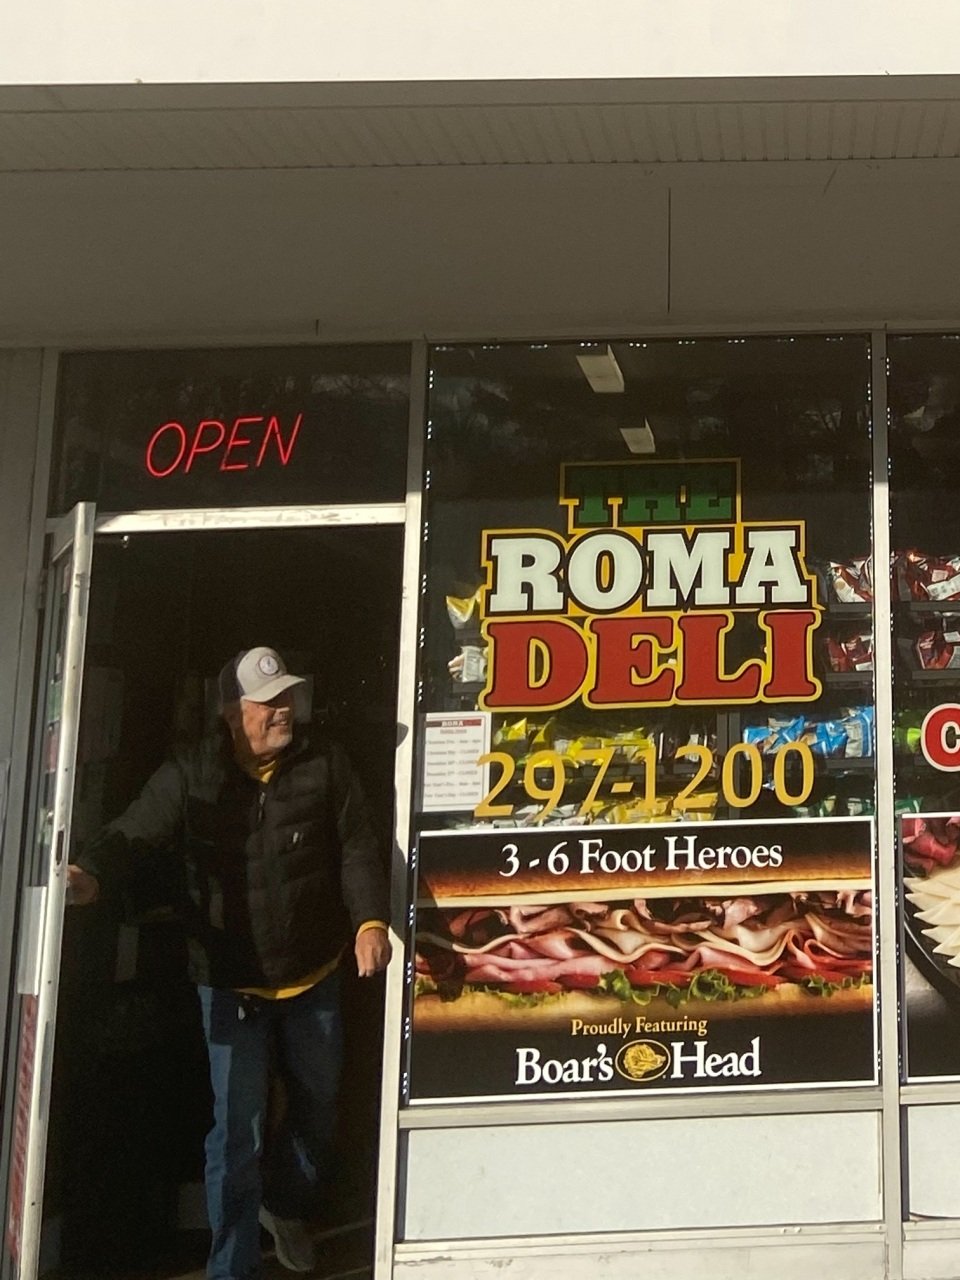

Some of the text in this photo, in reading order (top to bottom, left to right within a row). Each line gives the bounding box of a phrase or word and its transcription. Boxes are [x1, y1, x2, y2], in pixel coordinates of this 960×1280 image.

[145, 413, 303, 478] OPEN
[563, 461, 739, 525] THE
[487, 528, 810, 614] ROMA
[483, 611, 820, 708] DELI
[474, 741, 815, 820] 297-1200
[498, 843, 519, 877] 3
[547, 841, 570, 875] 6
[579, 838, 657, 874] Foot
[664, 835, 783, 872] Heroes
[571, 1016, 708, 1038] Proudly Featuring
[515, 1036, 762, 1086] Boar's Head
